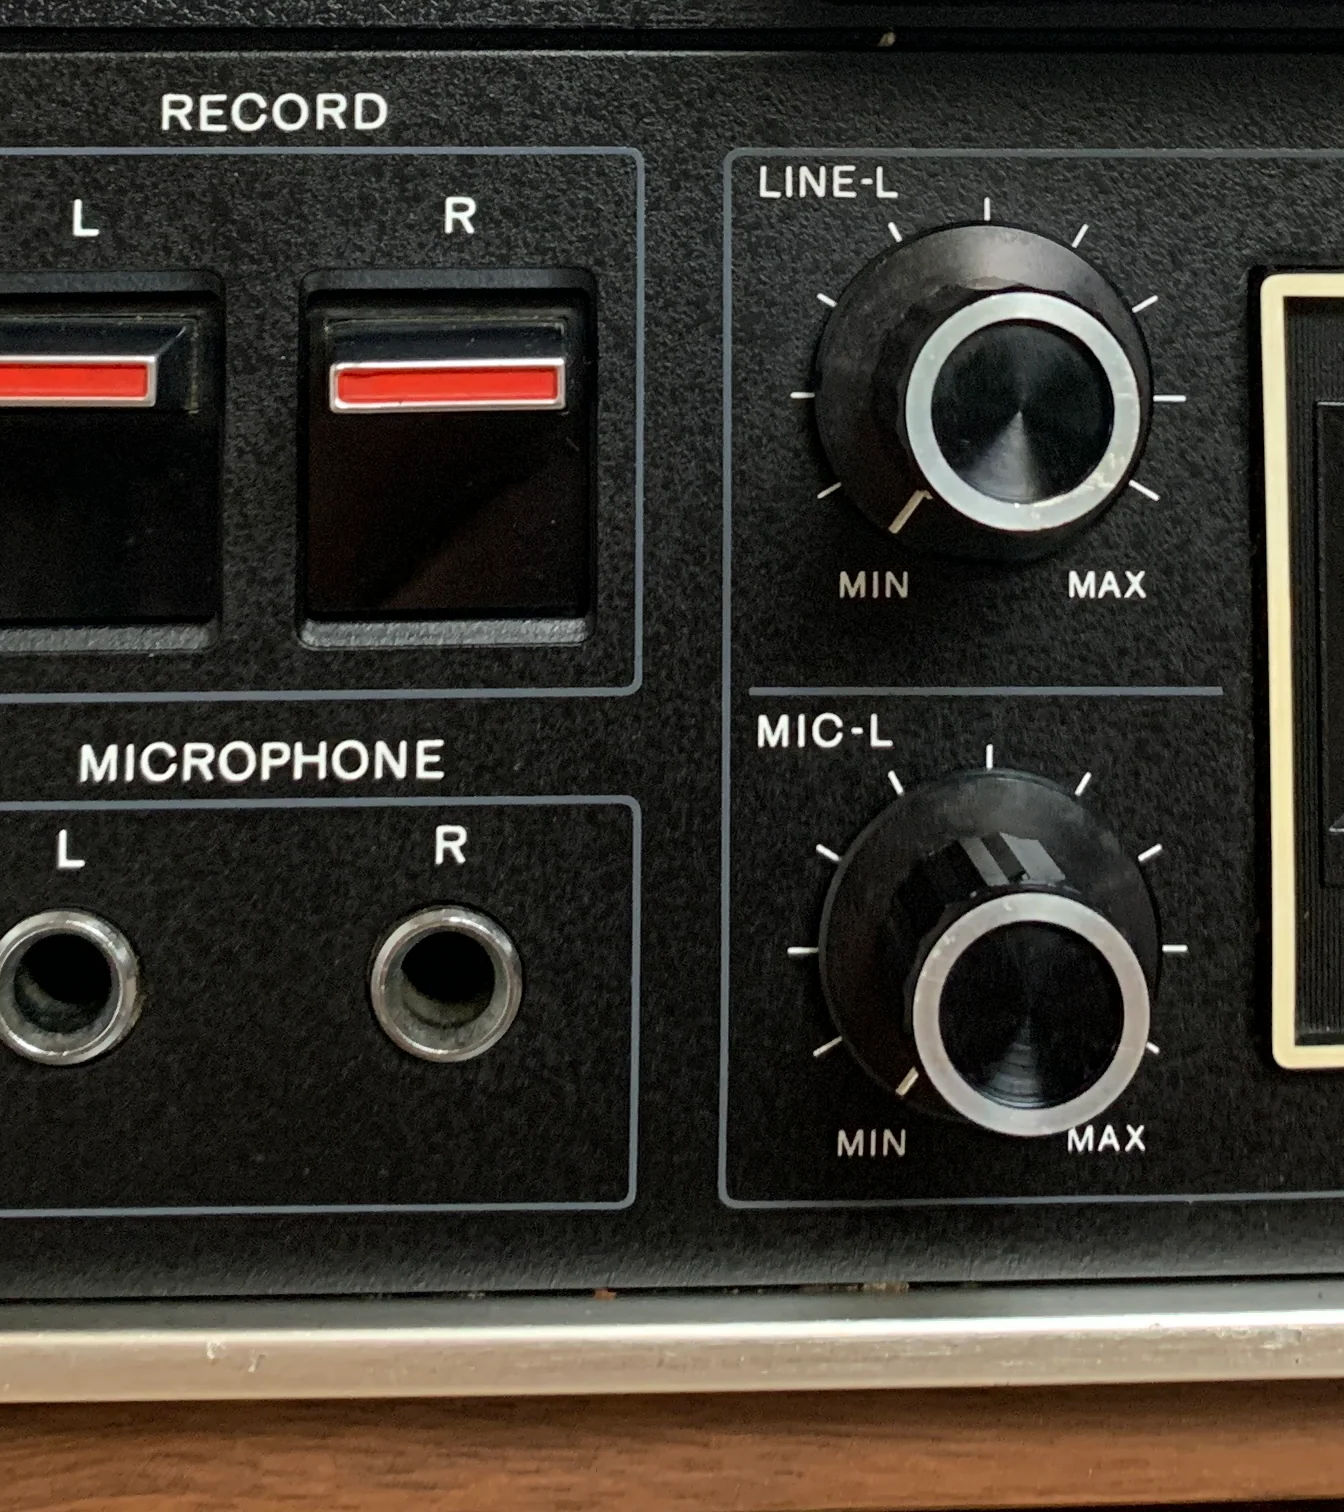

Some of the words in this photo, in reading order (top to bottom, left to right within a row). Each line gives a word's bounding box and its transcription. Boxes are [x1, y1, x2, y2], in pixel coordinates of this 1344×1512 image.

[161, 92, 388, 133] RECORD
[759, 164, 899, 199] LINE-L
[72, 198, 100, 237] L
[444, 196, 477, 235] R
[839, 570, 909, 599] MIN
[1068, 570, 1147, 599] MAX
[757, 712, 894, 749] MIC-L
[79, 739, 446, 783] MICROPHONE
[57, 829, 86, 869] L
[435, 824, 468, 865] R
[837, 1128, 907, 1157] MIN
[1067, 1123, 1146, 1153] MAX
